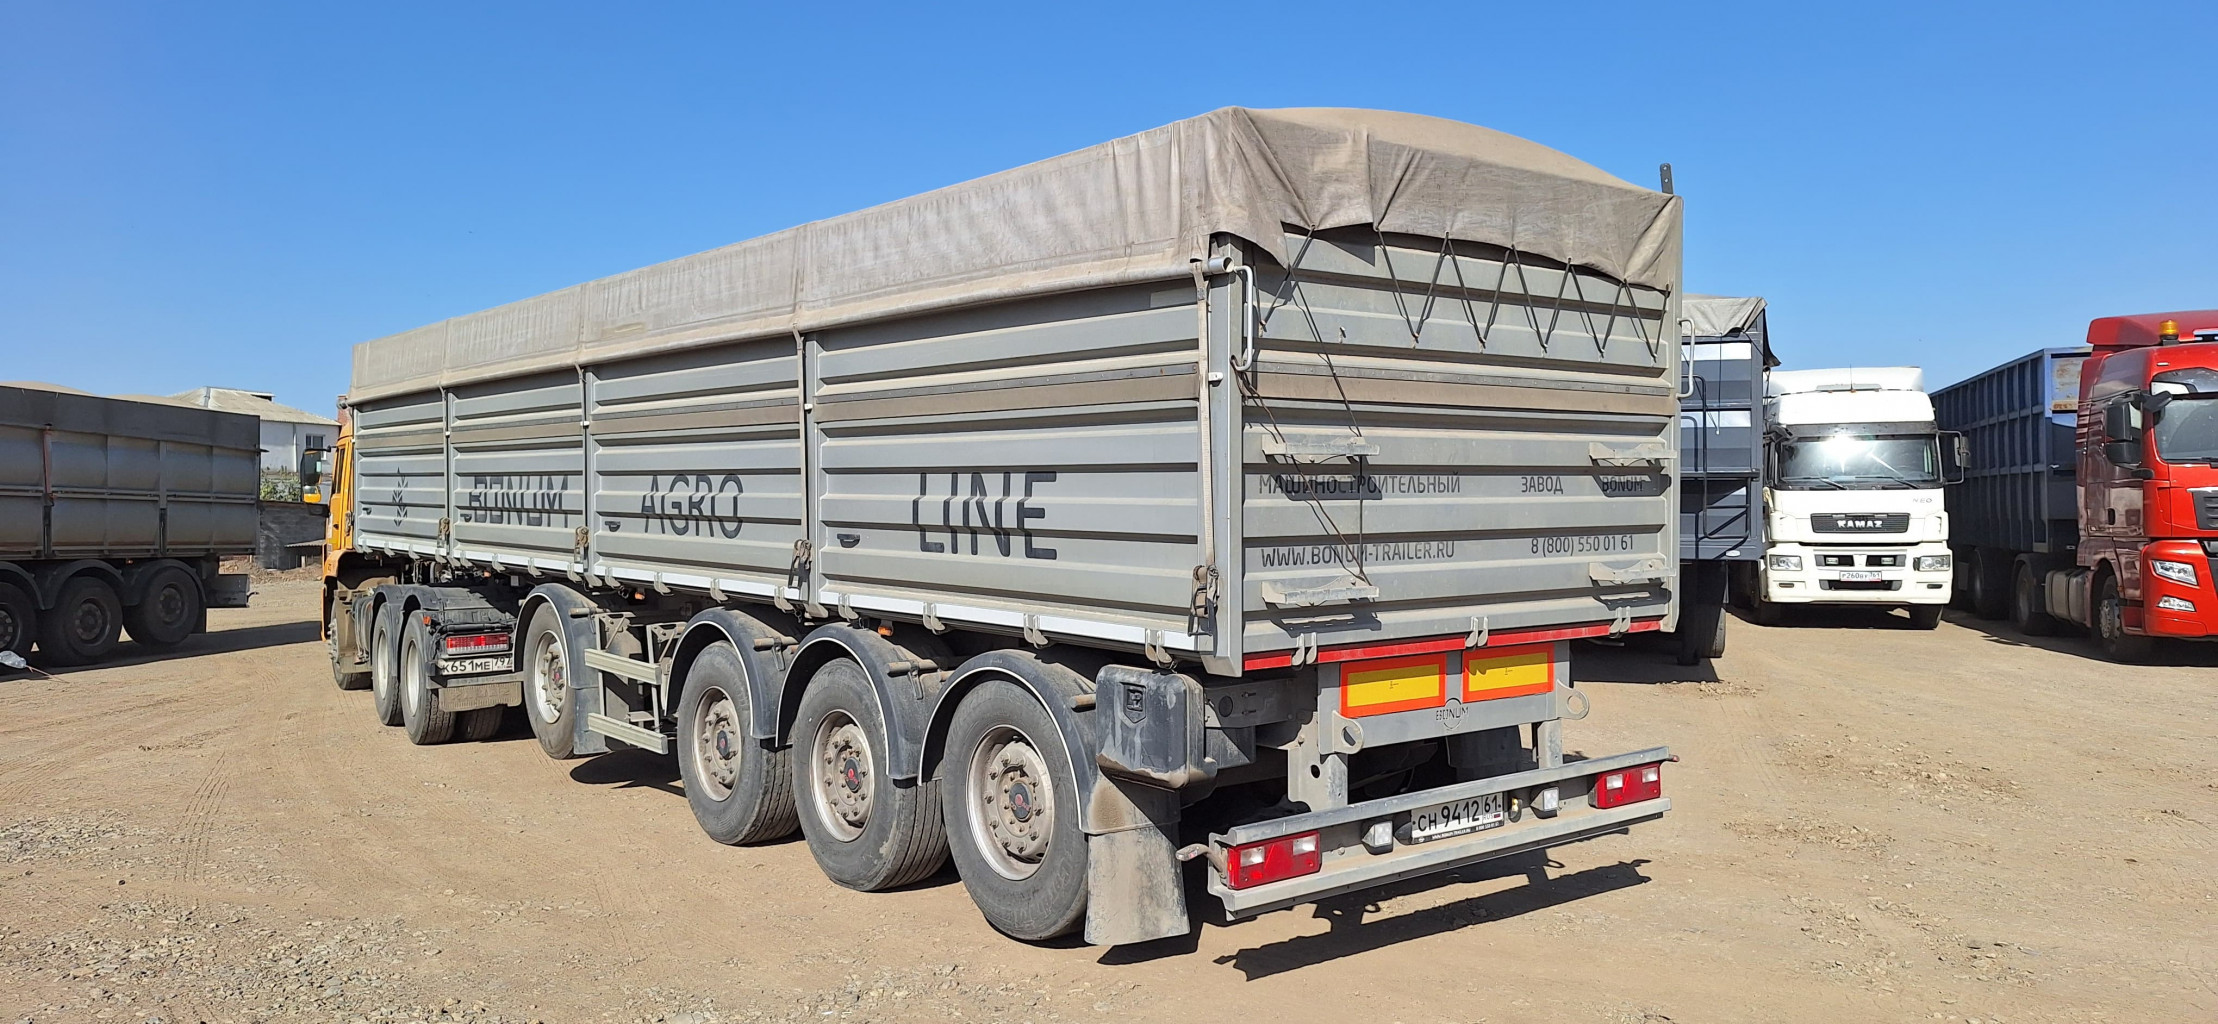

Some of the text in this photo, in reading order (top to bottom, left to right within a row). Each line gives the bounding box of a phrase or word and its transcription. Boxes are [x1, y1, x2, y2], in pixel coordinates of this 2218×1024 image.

[1521, 475, 1564, 495] ЗАВОД
[1602, 475, 1644, 492] BONUM
[469, 471, 1057, 560] BONUM AGRO LINE
[1836, 520, 1883, 528] KAMAZ
[1261, 540, 1455, 568] WWW.BONUM-TRAILER.RU
[1531, 534, 1634, 557] 8 (800) 550 01 61
